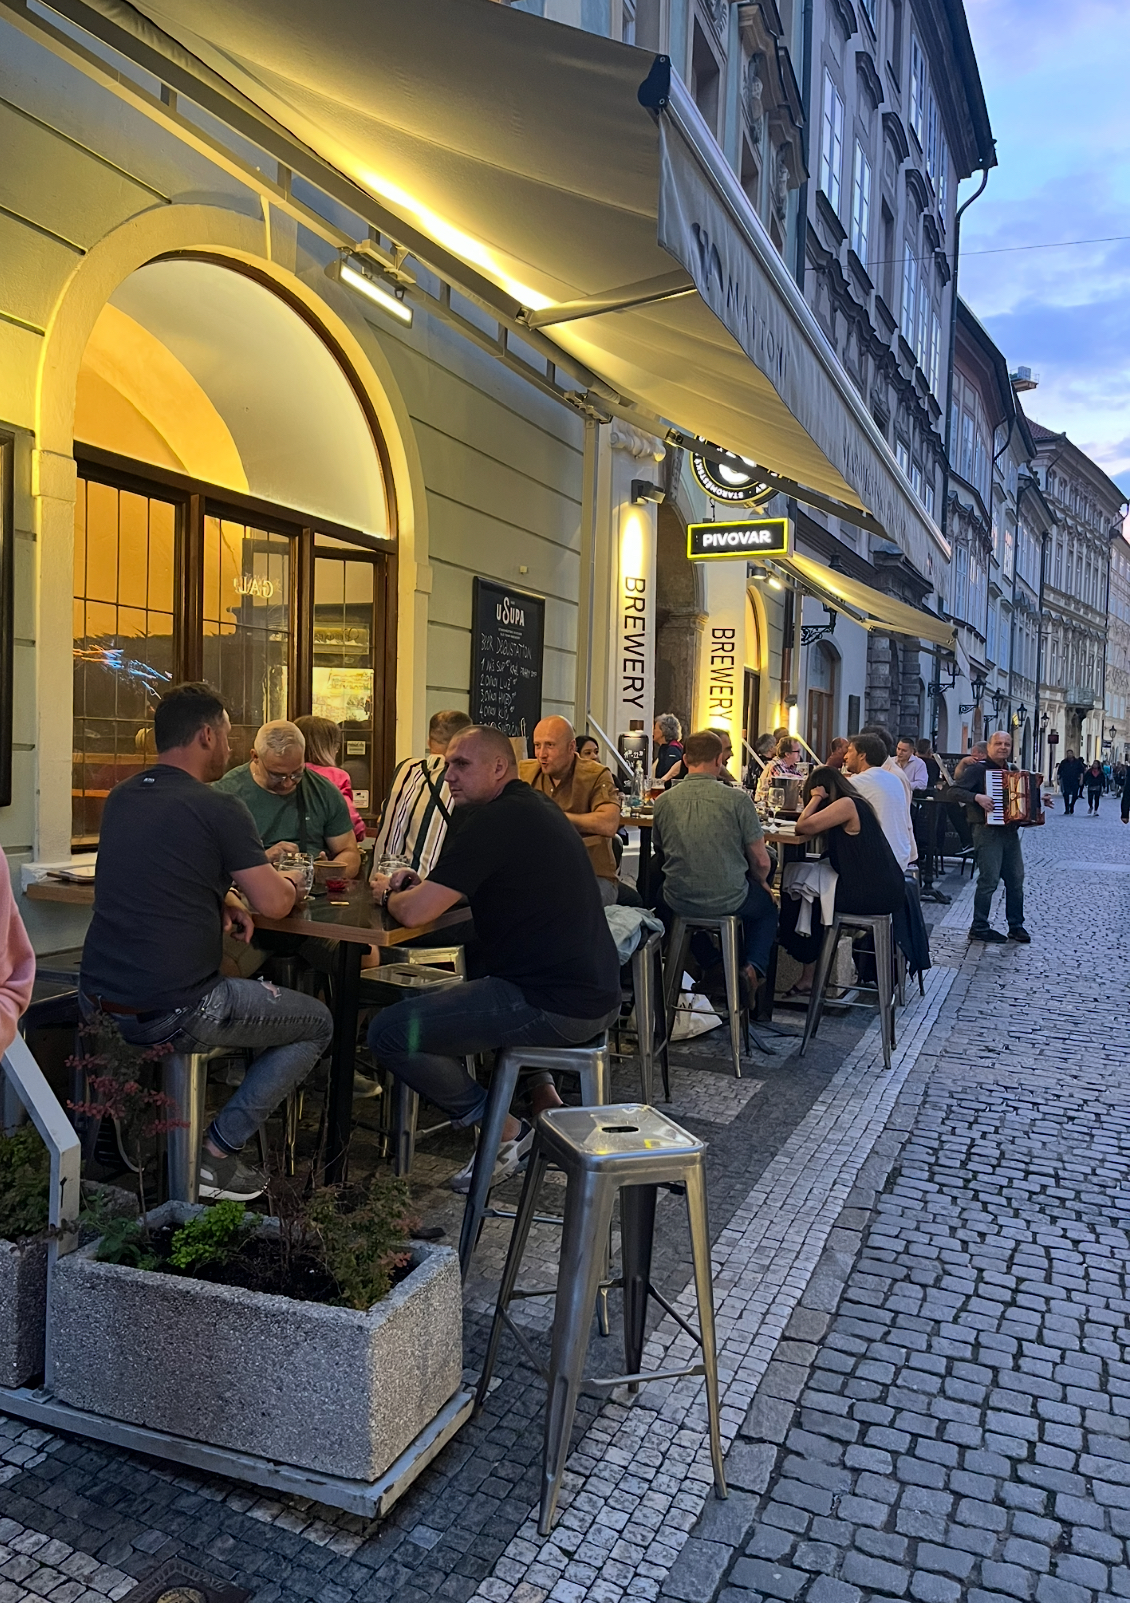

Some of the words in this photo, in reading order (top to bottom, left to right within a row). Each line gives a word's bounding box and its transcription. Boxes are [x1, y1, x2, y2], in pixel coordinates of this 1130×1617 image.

[702, 529, 772, 547] PIVOVAR
[622, 576, 646, 710] BREWERY
[709, 627, 736, 721] BREWERY
